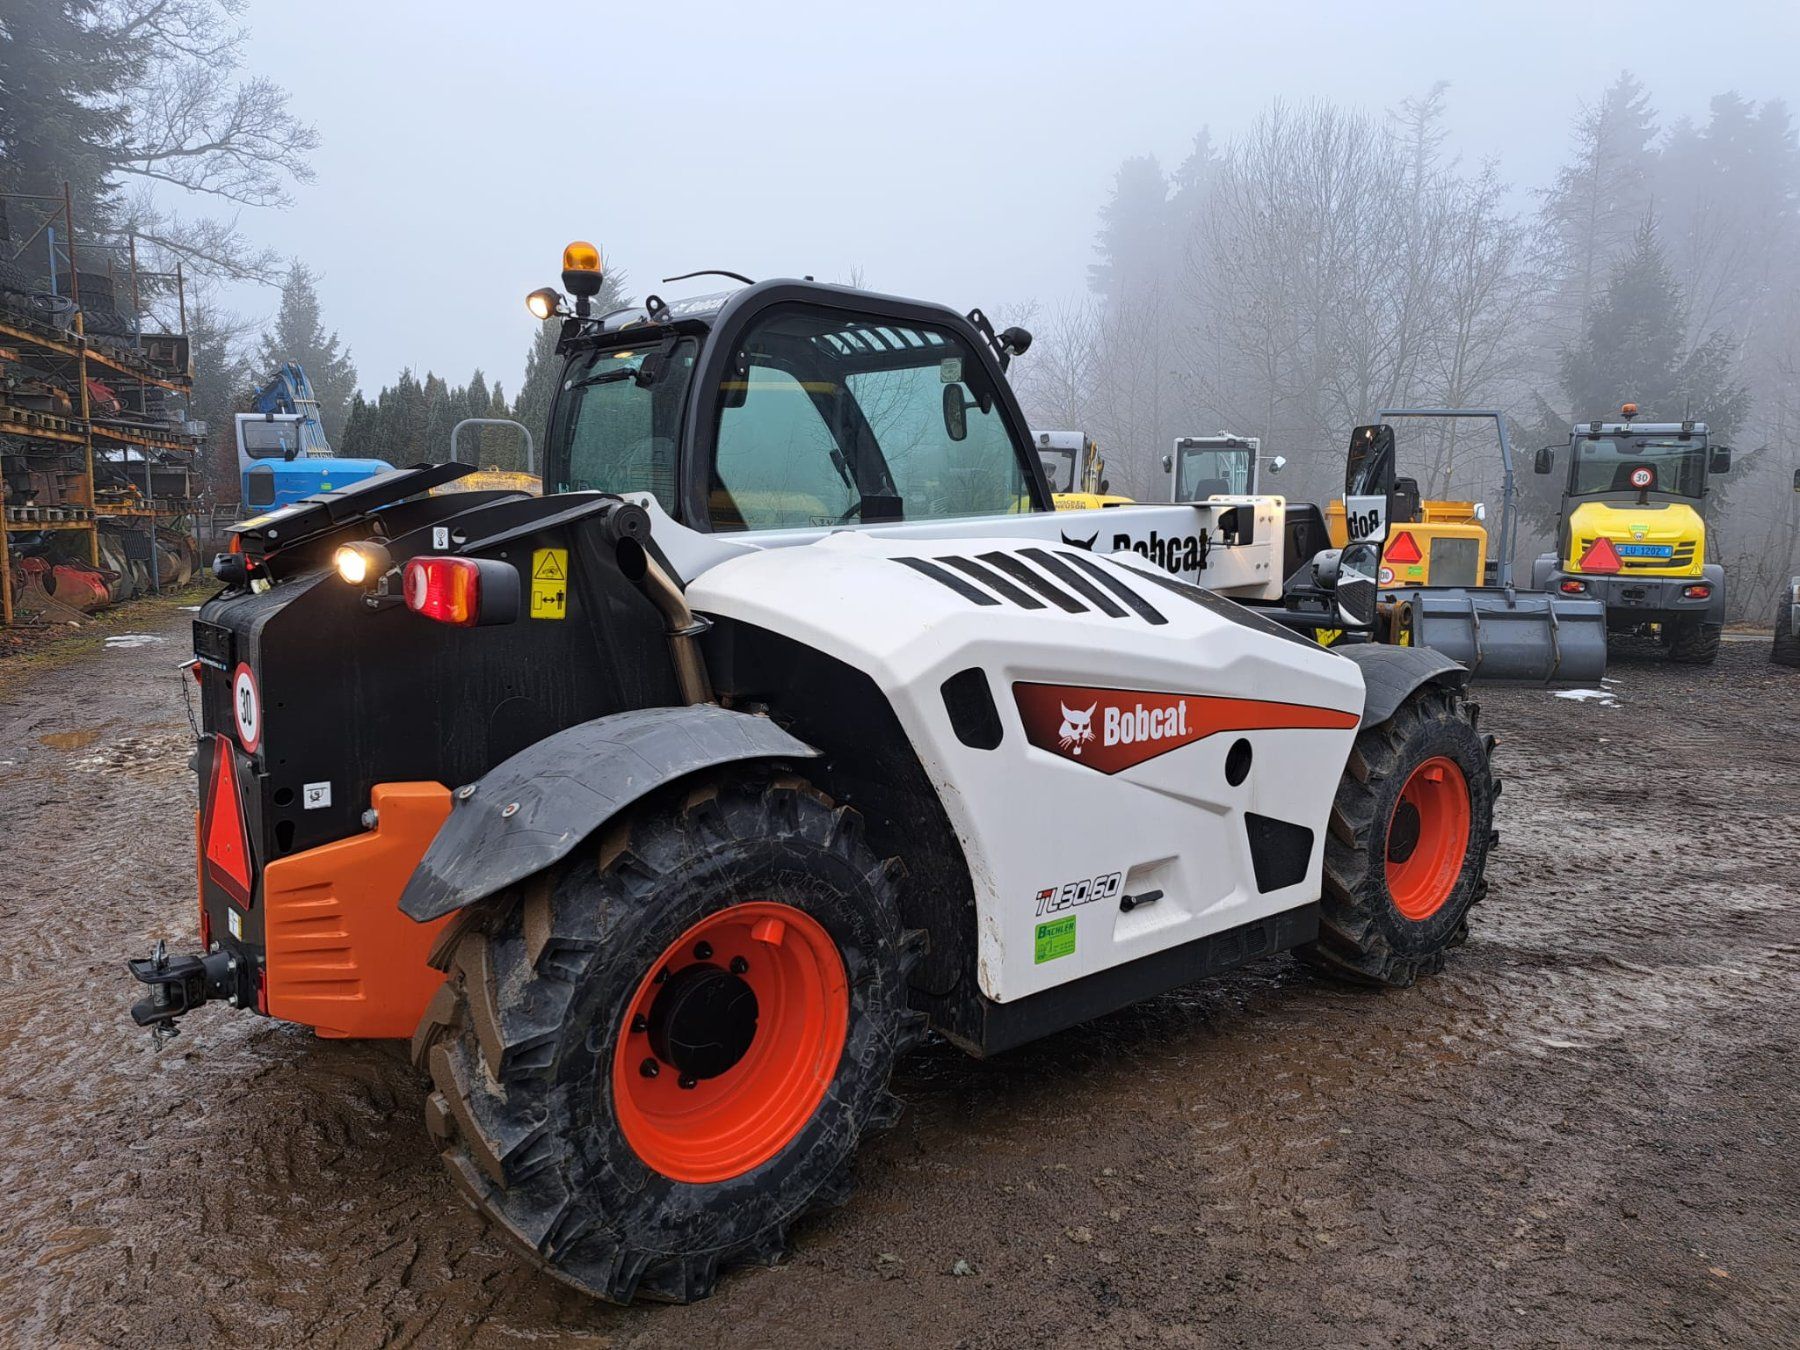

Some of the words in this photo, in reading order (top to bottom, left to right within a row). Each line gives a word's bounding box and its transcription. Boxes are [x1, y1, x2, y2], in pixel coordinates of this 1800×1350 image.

[1635, 472, 1648, 483] 30
[1625, 547, 1636, 555] LU
[240, 687, 252, 726] 30
[1104, 700, 1186, 746] Bobcat
